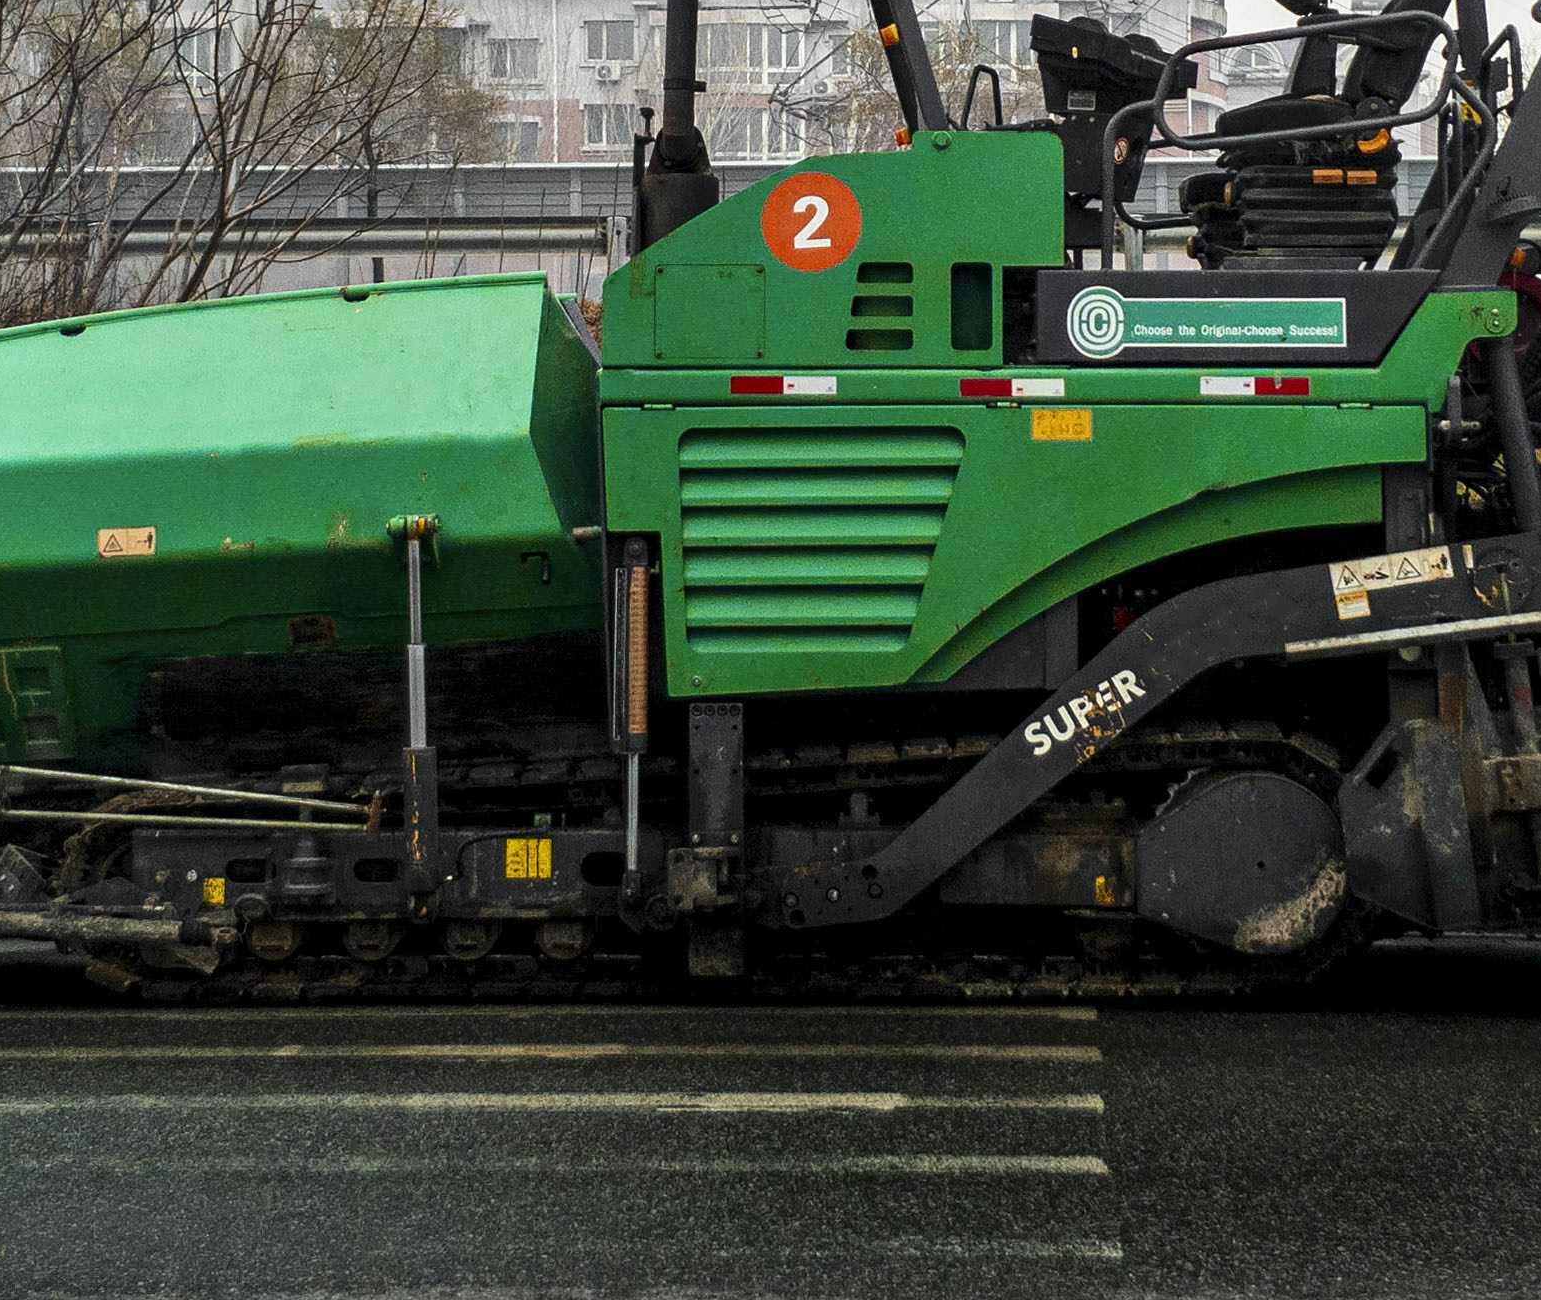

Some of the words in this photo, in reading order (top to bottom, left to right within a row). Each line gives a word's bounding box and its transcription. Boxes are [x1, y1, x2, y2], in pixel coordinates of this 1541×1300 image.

[793, 195, 832, 250] 2
[1134, 324, 1173, 336] Choose
[1178, 324, 1196, 336] the
[1289, 324, 1338, 337] Success!
[1024, 669, 1146, 756] SUPER
